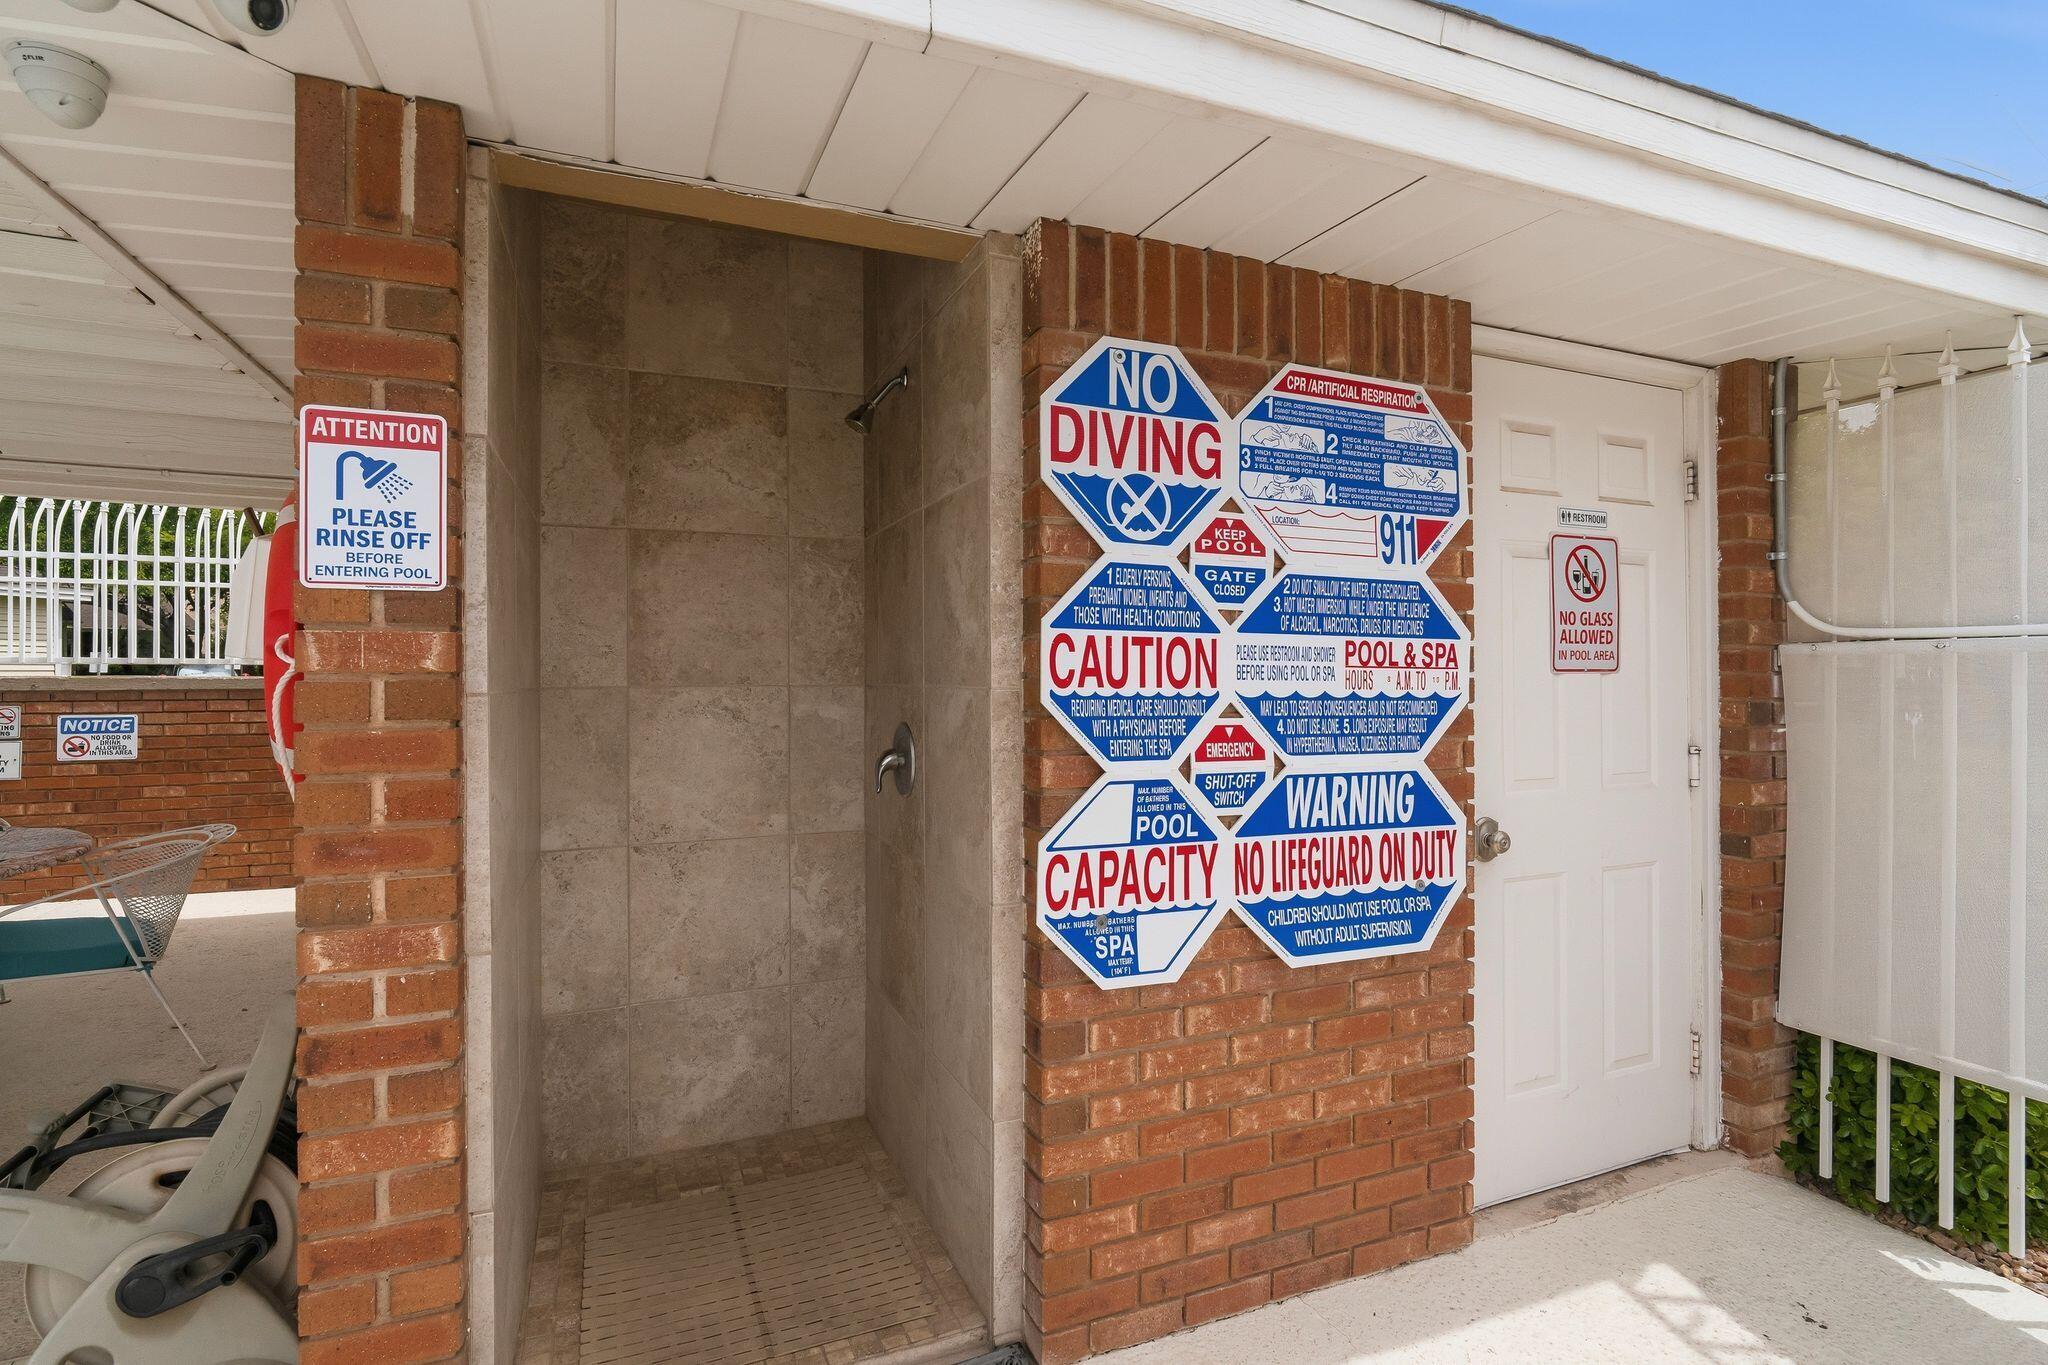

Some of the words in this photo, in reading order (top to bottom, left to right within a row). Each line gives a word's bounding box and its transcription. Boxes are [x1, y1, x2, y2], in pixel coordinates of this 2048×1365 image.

[1109, 348, 1177, 413] NO
[1287, 376, 1305, 391] CPR
[1361, 388, 1417, 408] RESPIRATION
[312, 416, 437, 445] ATTENTION
[1051, 405, 1221, 479] DIVING
[332, 508, 416, 528] PLEASE
[1272, 516, 1300, 525] LOCATION:
[1573, 513, 1606, 524] RESTROOM
[316, 528, 384, 548] RINSE
[391, 532, 431, 550] OFF
[1215, 528, 1246, 540] KEEP
[1380, 514, 1416, 565] 911
[1202, 539, 1260, 553] POOL
[346, 552, 403, 564] BEFORE
[315, 565, 388, 578] ENTERING
[394, 568, 432, 579] POOL
[1107, 568, 1112, 584] 1
[1116, 568, 1142, 586] ELDERLY
[1143, 570, 1172, 589] PERSONS,
[1205, 570, 1256, 583] GATE
[1089, 587, 1121, 605] PREGNANT
[1123, 589, 1148, 608] WOMEN,
[1149, 590, 1173, 607] INFANTS
[1175, 591, 1187, 607] AND
[1214, 584, 1245, 596] CLOSED
[1284, 578, 1290, 594] 2
[1292, 580, 1300, 594] DO
[1301, 581, 1312, 595] NOT
[1313, 581, 1338, 596] SWALLOW
[1340, 583, 1350, 597] THE
[1351, 583, 1369, 600] WATER,
[1371, 584, 1376, 598] IT
[1377, 584, 1382, 598] IS
[1382, 584, 1420, 600] RECIRCULATED.
[1274, 597, 1282, 612] 3.
[1284, 597, 1295, 613] HOT
[1296, 598, 1315, 613] WATER
[1316, 599, 1346, 615] IMMERSION
[1350, 600, 1366, 616] WHILE
[1367, 601, 1384, 617] UNDER
[1386, 602, 1396, 617] THE
[1397, 602, 1429, 618] INFLUENCE
[1074, 607, 1099, 624] THOSE
[1102, 608, 1121, 624] WITH
[1124, 609, 1152, 626] HEALTH
[1155, 610, 1200, 628] CONDITIONS
[1281, 617, 1289, 631] OF
[1291, 617, 1321, 634] ALCOHOL,
[1323, 618, 1359, 635] NARCOTICS,
[1361, 620, 1381, 634] DRUGS
[1382, 620, 1391, 634] OR
[1392, 621, 1423, 635] MEDICINES
[1560, 611, 1576, 625] NO
[1580, 612, 1613, 626] GLASS
[1560, 629, 1613, 644] ALLOWED
[1050, 633, 1217, 689] CAUTION
[1236, 645, 1257, 661] PLEASE
[1258, 645, 1269, 661] USE
[1270, 646, 1300, 661] RESTROOM
[1301, 647, 1313, 662] AND
[1313, 647, 1335, 662] SHOWER
[1345, 640, 1398, 667] POOL
[1404, 642, 1416, 667] &
[1422, 642, 1458, 668] SPA
[1558, 651, 1567, 660] IN
[1570, 650, 1591, 660] POOL
[1594, 651, 1614, 660] AREA
[1237, 665, 1265, 681] BEFORE
[1266, 665, 1289, 681] USING
[1290, 666, 1309, 681] POOL
[1311, 666, 1321, 681] OR
[1323, 666, 1335, 682] SPA
[1345, 670, 1373, 690] HOURS
[1396, 672, 1413, 690] A.M.
[1416, 672, 1426, 690] TO
[1445, 672, 1460, 690] P.M.
[1072, 700, 1105, 717] REQUIRING
[1108, 700, 1135, 716] MEDICAL
[1137, 700, 1152, 716] CARE
[1154, 700, 1178, 716] SHOULD
[1179, 700, 1206, 716] CONSULT
[1260, 701, 1272, 716] MAY
[1274, 701, 1289, 716] LEAD
[1290, 701, 1297, 716] TO
[1298, 701, 1322, 716] SERIOUS
[1324, 701, 1366, 716] CONSEQUENCES
[1368, 701, 1379, 715] AND
[1380, 701, 1385, 715] IS
[1386, 701, 1397, 715] NOT
[1398, 701, 1437, 715] RECOMMENDED
[64, 719, 132, 731] NOTICE
[1092, 720, 1110, 737] WITH
[1113, 720, 1118, 737] A
[1120, 719, 1157, 737] PHYSICIAN
[1159, 719, 1186, 736] BEFORE
[1277, 719, 1286, 735] 4.
[1287, 720, 1295, 734] DO
[1297, 719, 1308, 734] NOT
[1310, 719, 1320, 734] USE
[1322, 719, 1341, 734] ALONE.
[1353, 719, 1367, 733] LONG
[1368, 719, 1395, 734] EXPOSURE
[1397, 718, 1407, 733] MAY
[1408, 718, 1427, 732] RESULT
[1110, 740, 1143, 757] ENTERING
[1145, 739, 1158, 755] THE
[1159, 739, 1172, 755] SPA
[1206, 742, 1254, 757] EMERGENCY
[1287, 737, 1292, 753] IN
[1362, 736, 1388, 751] DIZZINESS
[1389, 736, 1396, 750] OR
[1397, 736, 1420, 750] FAINTING
[1205, 774, 1256, 789] SHUT-OFF
[1137, 804, 1164, 812] ALLOWED
[1173, 802, 1186, 810] THIS
[1215, 791, 1244, 805] SWITCH
[1286, 773, 1415, 828] WARNING
[1136, 813, 1198, 840] POOL
[1235, 840, 1264, 895] NO
[1272, 835, 1373, 892] LIFEGUARD
[1380, 833, 1405, 883] ON
[1413, 830, 1457, 880] DUTY
[1045, 843, 1218, 911] CAPACITY
[1268, 906, 1310, 926] CHILDREN
[1312, 904, 1345, 922] SHOULD
[1347, 904, 1363, 919] NOT
[1364, 901, 1380, 917] USE
[1381, 899, 1403, 916] POOL
[1404, 898, 1415, 913] OR
[1416, 896, 1432, 912] SPA
[1295, 927, 1333, 947] WITHOUT
[1335, 925, 1359, 942] ADULT
[1361, 920, 1412, 941] SUPERVISION
[1095, 934, 1134, 959] SPA
